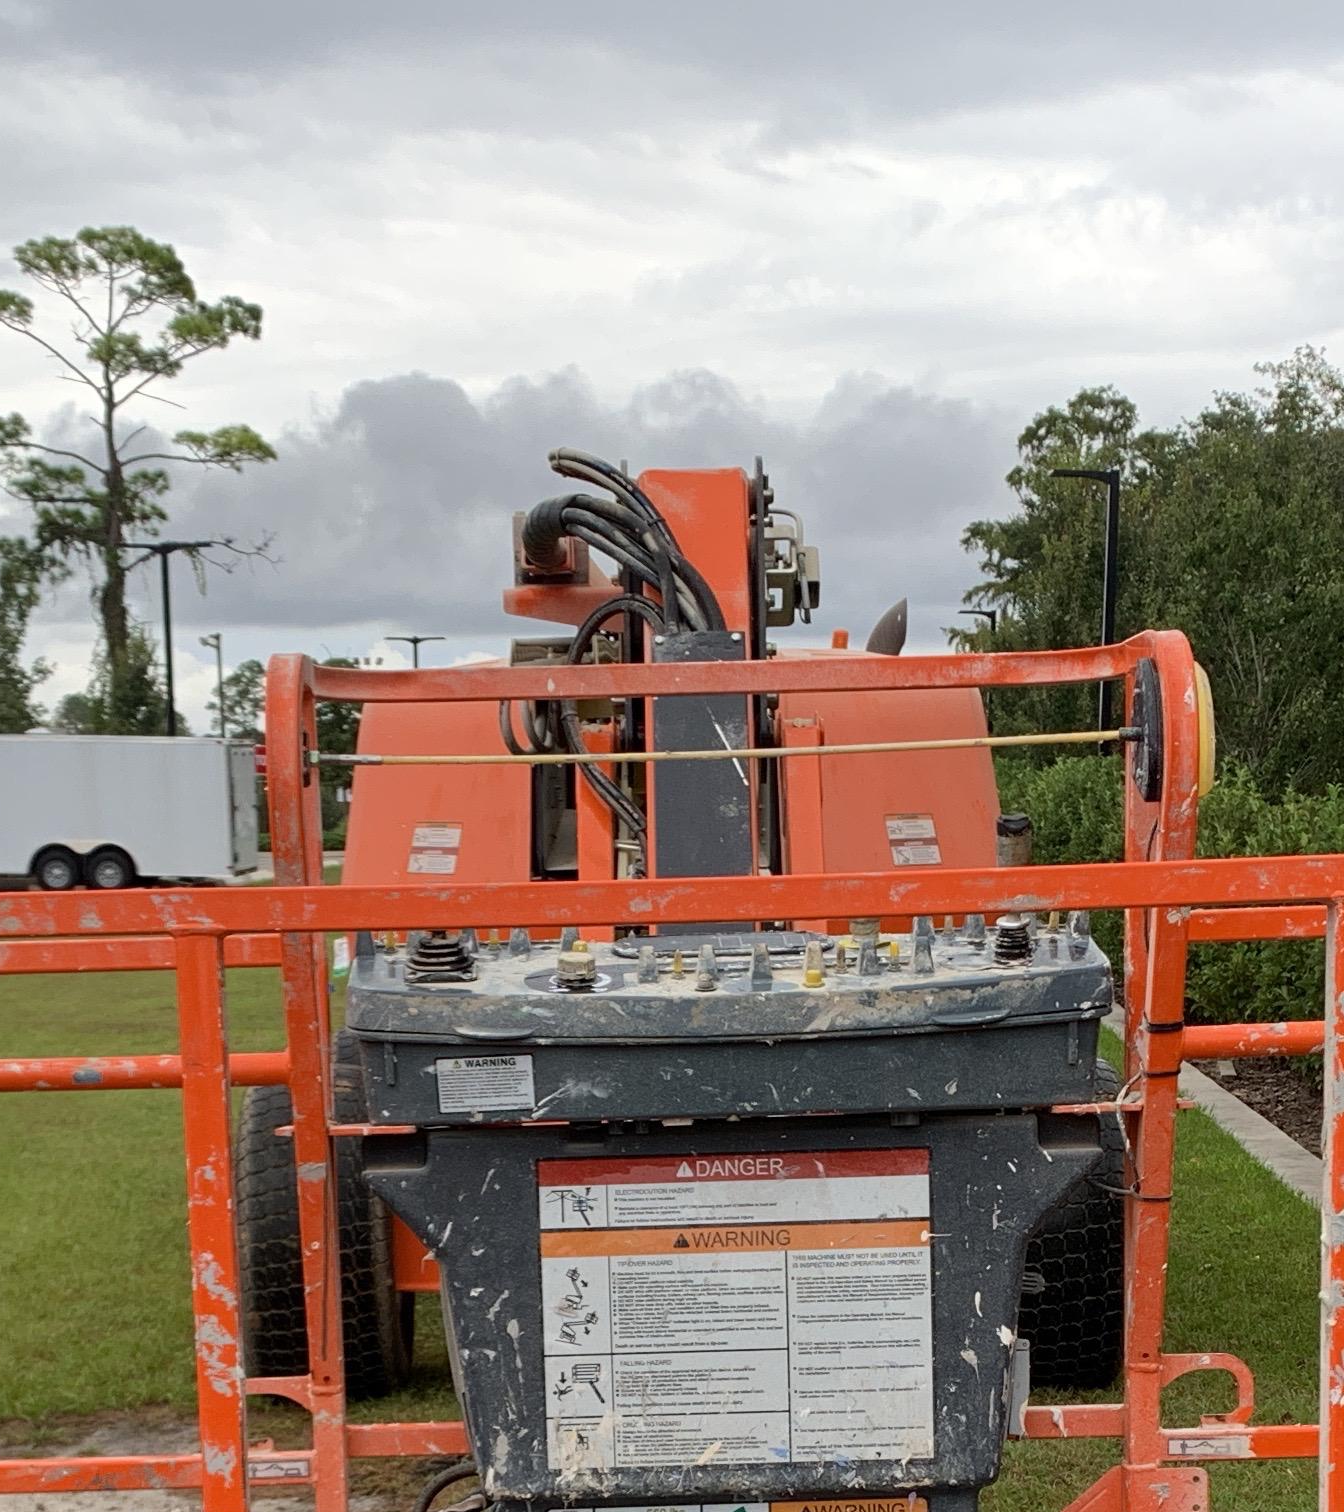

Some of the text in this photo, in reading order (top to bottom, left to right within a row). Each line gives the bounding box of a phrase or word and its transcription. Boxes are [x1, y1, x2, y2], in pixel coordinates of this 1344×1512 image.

[464, 1058, 517, 1068] WARNING
[696, 1158, 784, 1178] DANGER
[615, 1188, 668, 1196] ELECTROCUTION
[691, 1230, 792, 1249] WARNING
